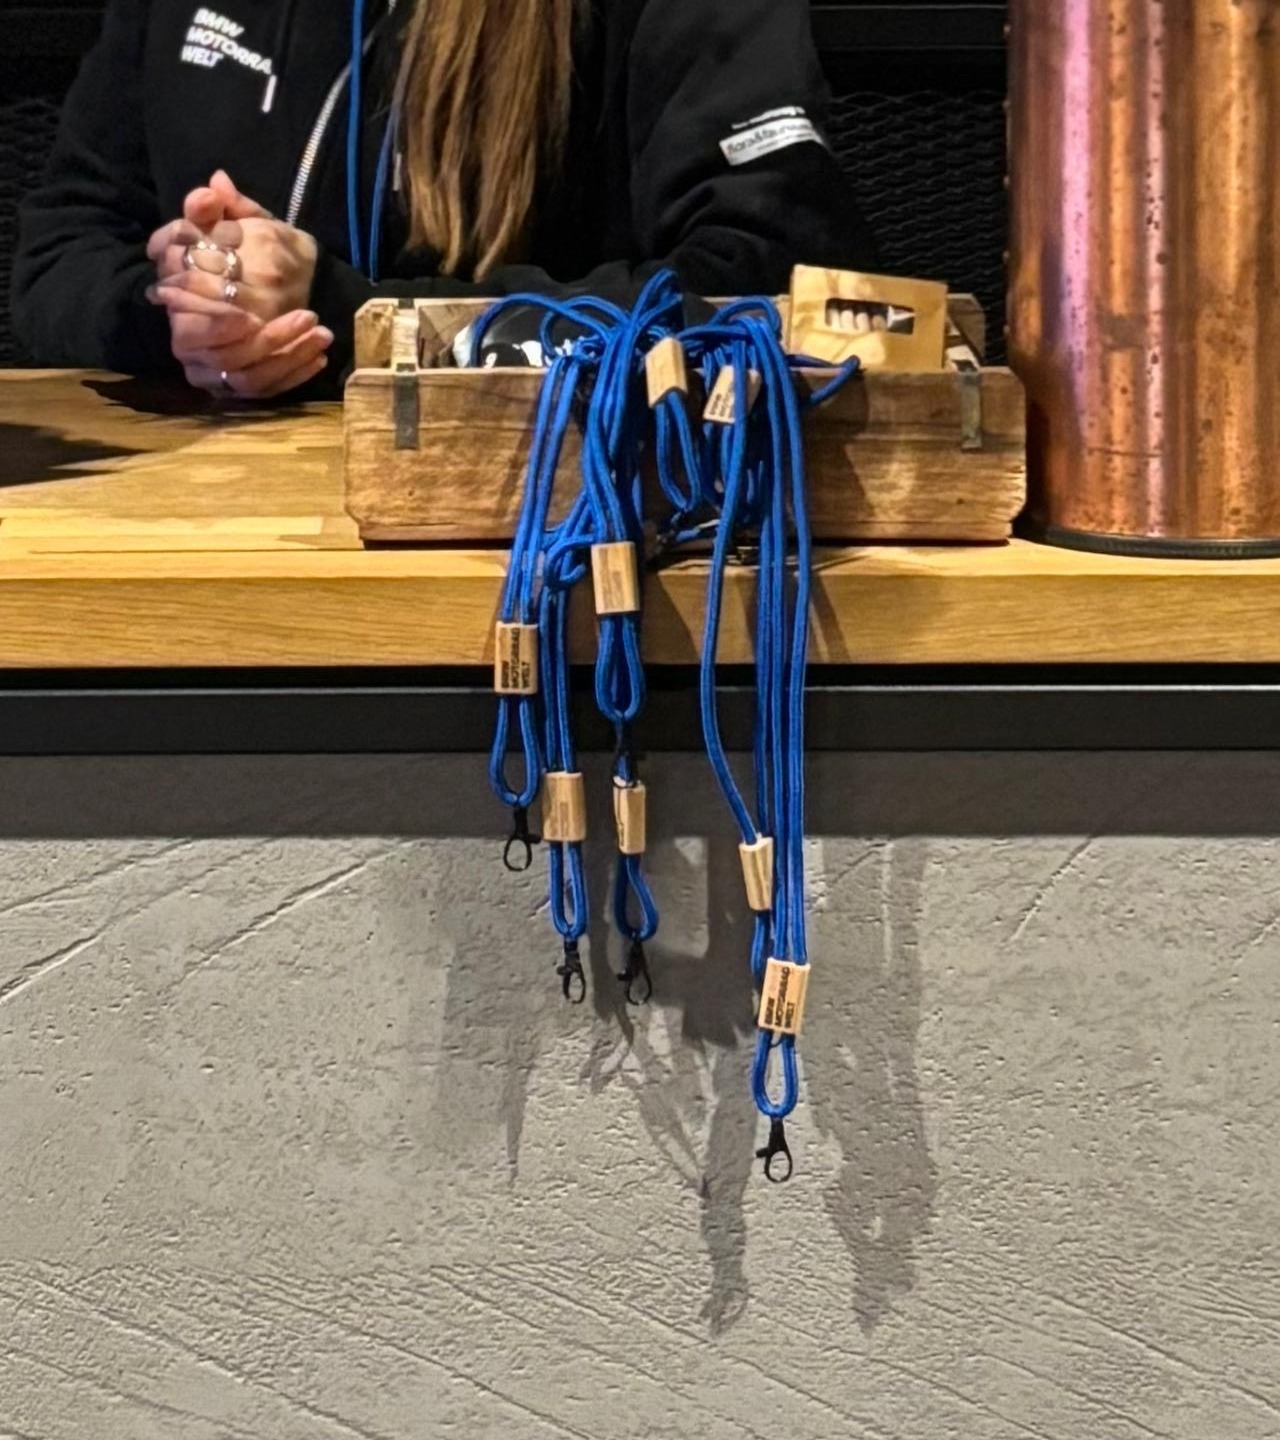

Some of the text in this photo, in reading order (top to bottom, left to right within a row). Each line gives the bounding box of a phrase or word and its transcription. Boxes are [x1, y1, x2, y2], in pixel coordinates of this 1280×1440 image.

[194, 7, 245, 39] BMW
[180, 45, 225, 69] WELT
[186, 25, 273, 76] MOTORRA
